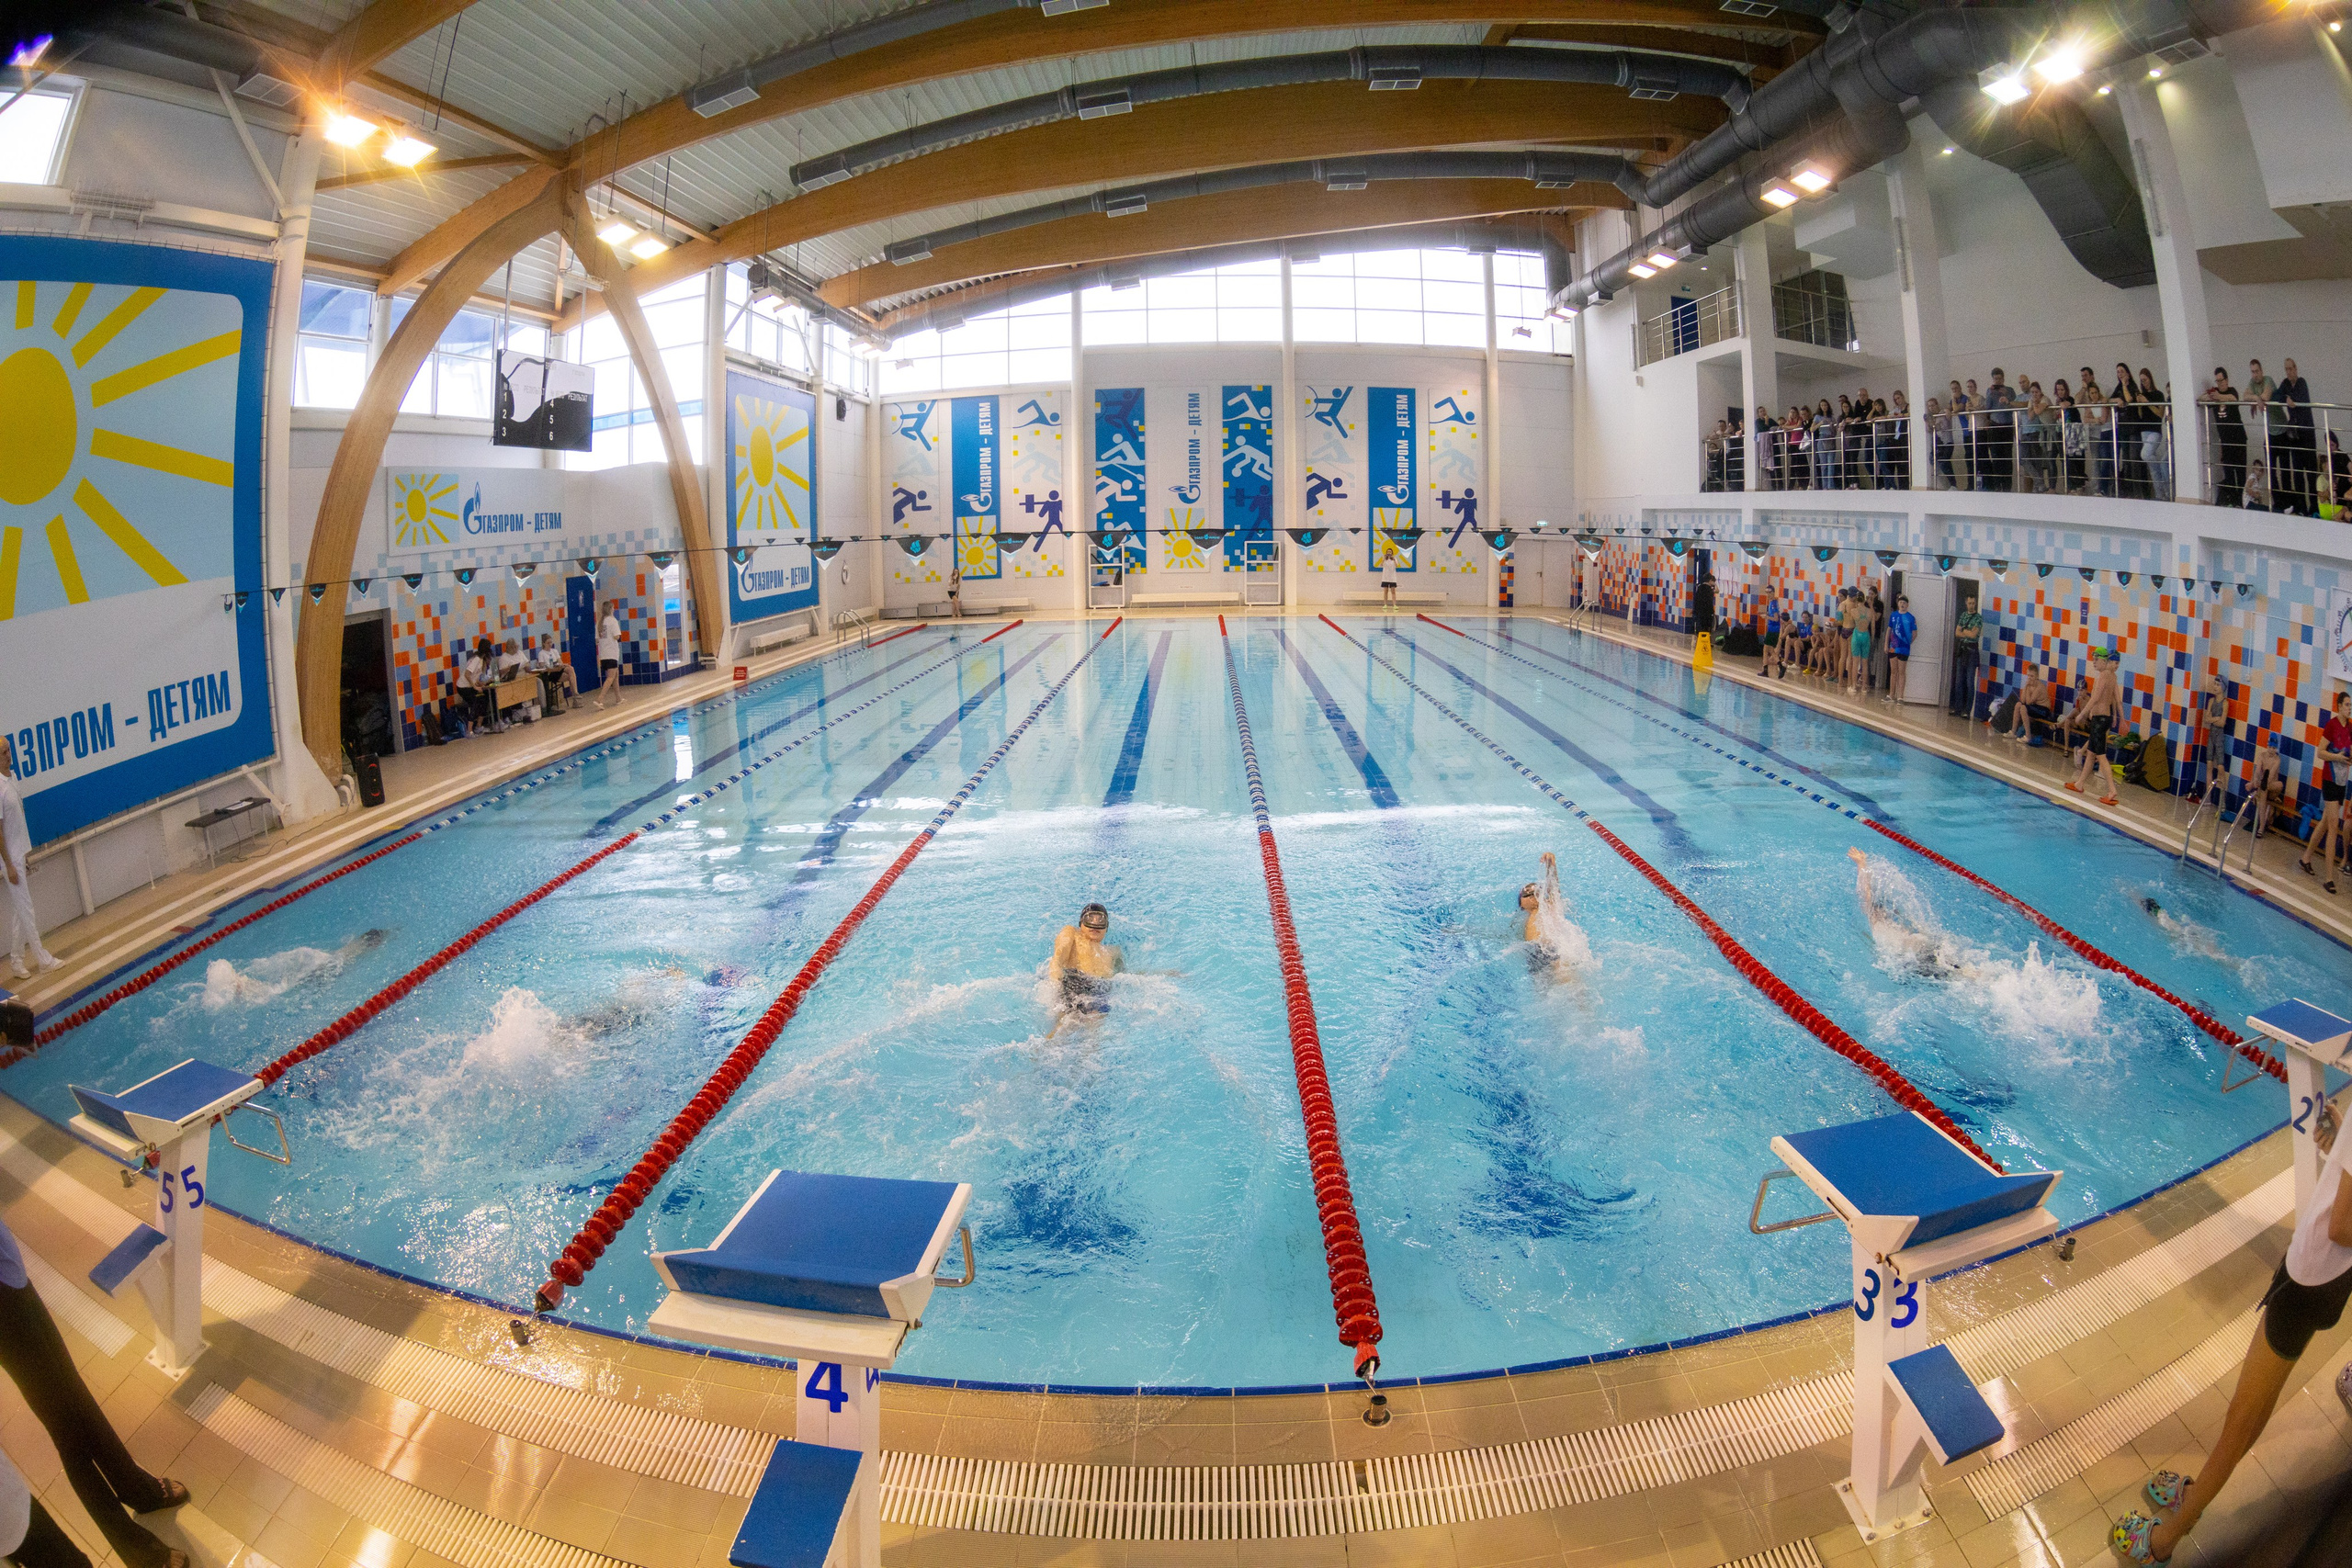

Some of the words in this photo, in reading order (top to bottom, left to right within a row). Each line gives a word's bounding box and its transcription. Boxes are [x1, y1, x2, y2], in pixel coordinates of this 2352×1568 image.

[503, 392, 507, 401] 1
[549, 399, 554, 408] 4
[1188, 392, 1202, 426] ДЕТЯМ
[1396, 394, 1410, 428] ДЕТЯМ
[502, 426, 506, 436] 3
[503, 409, 506, 419] 2
[549, 415, 554, 423] 5
[978, 402, 993, 435] ДЕТЯМ
[549, 432, 553, 441] 6
[979, 446, 992, 492] ГАЗПРОМ
[1188, 439, 1201, 484] ГАЗПРОМ
[1396, 439, 1409, 485] ГАЗПРОМ
[482, 513, 524, 534] ГАЗПРОМ
[534, 513, 562, 534] ДЕТЯМ
[754, 570, 784, 592] ГАЗПРОМ
[791, 566, 809, 589] ДЕТЯМ
[5, 702, 116, 782] АЗПРОМ
[147, 670, 231, 743] ДЕТЯМ
[2292, 1096, 2313, 1134] 2
[160, 1171, 175, 1213] 5
[180, 1165, 204, 1209] 5
[1854, 1269, 1881, 1322] 3
[1891, 1277, 1918, 1328] 3
[805, 1361, 848, 1413] 4
